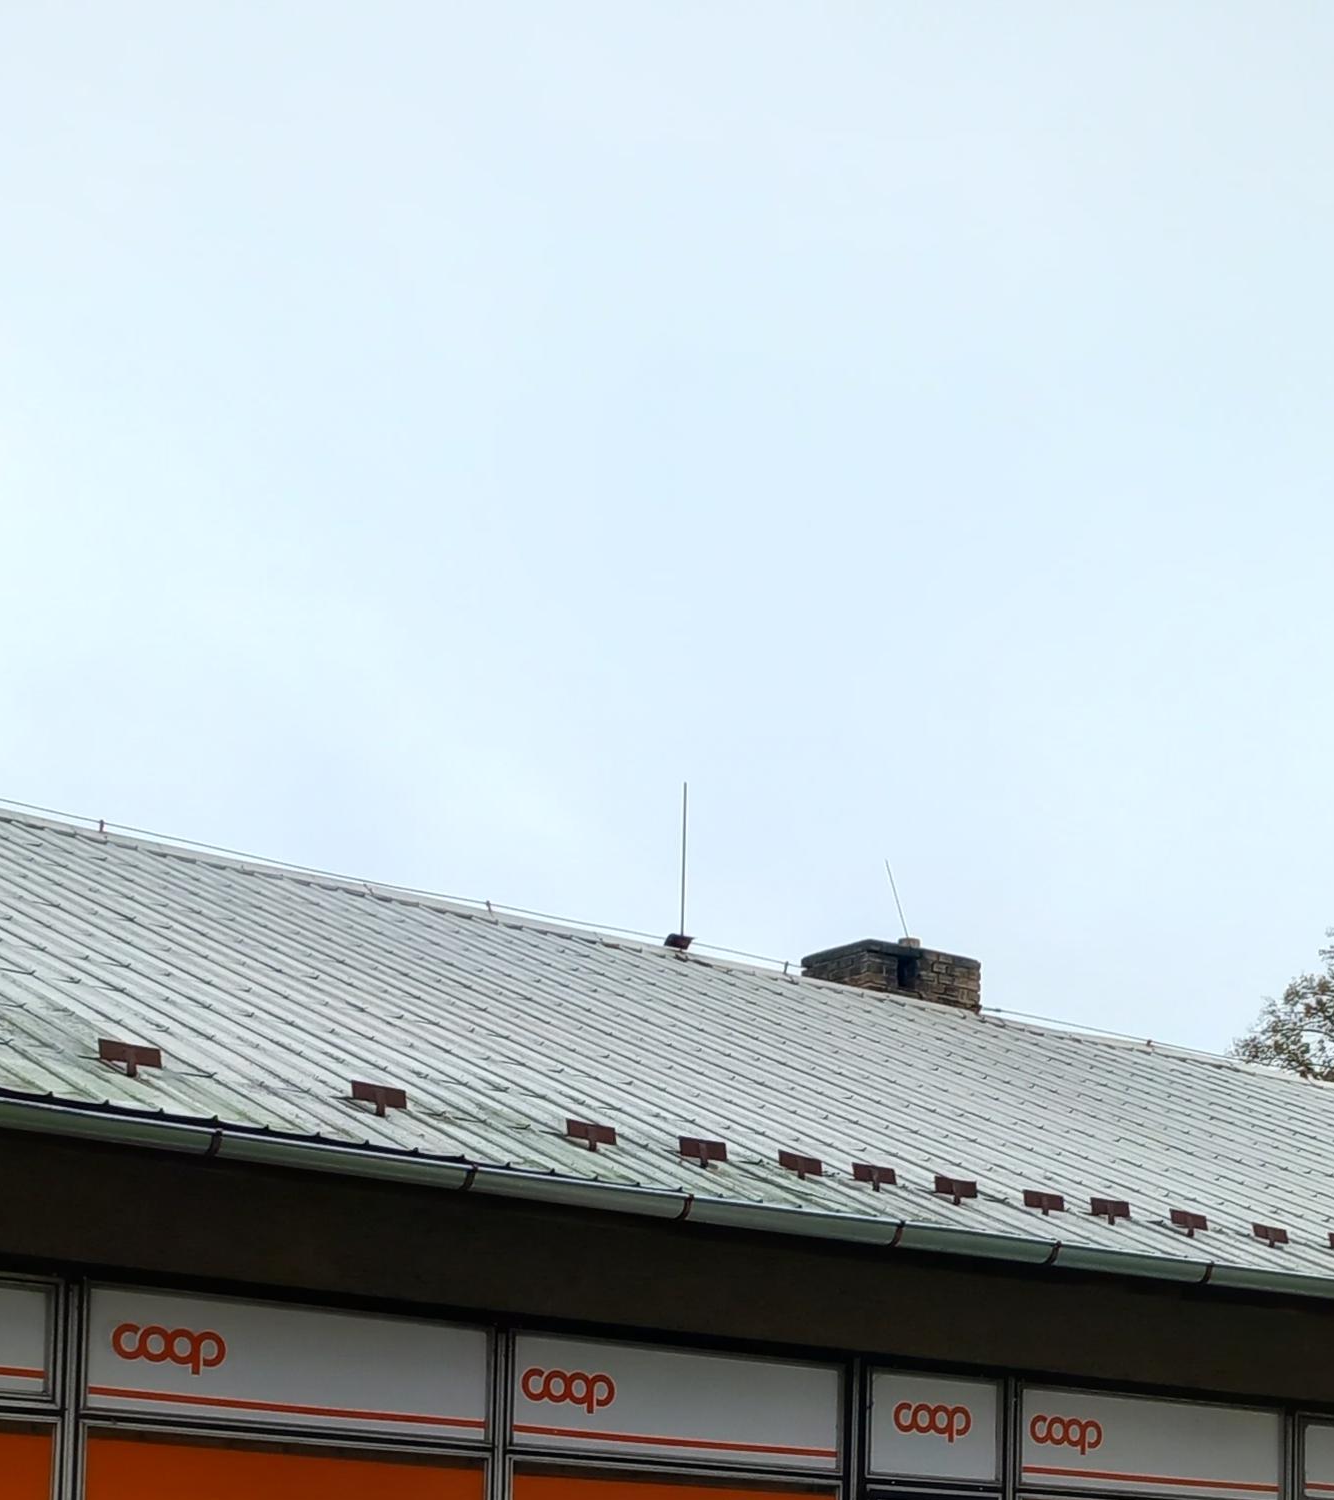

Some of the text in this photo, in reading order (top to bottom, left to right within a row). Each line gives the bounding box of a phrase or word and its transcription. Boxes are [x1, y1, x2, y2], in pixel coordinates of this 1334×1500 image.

[113, 1323, 226, 1374] coop
[523, 1369, 614, 1411] coop
[894, 1403, 971, 1442] coop
[1031, 1414, 1102, 1455] coop
